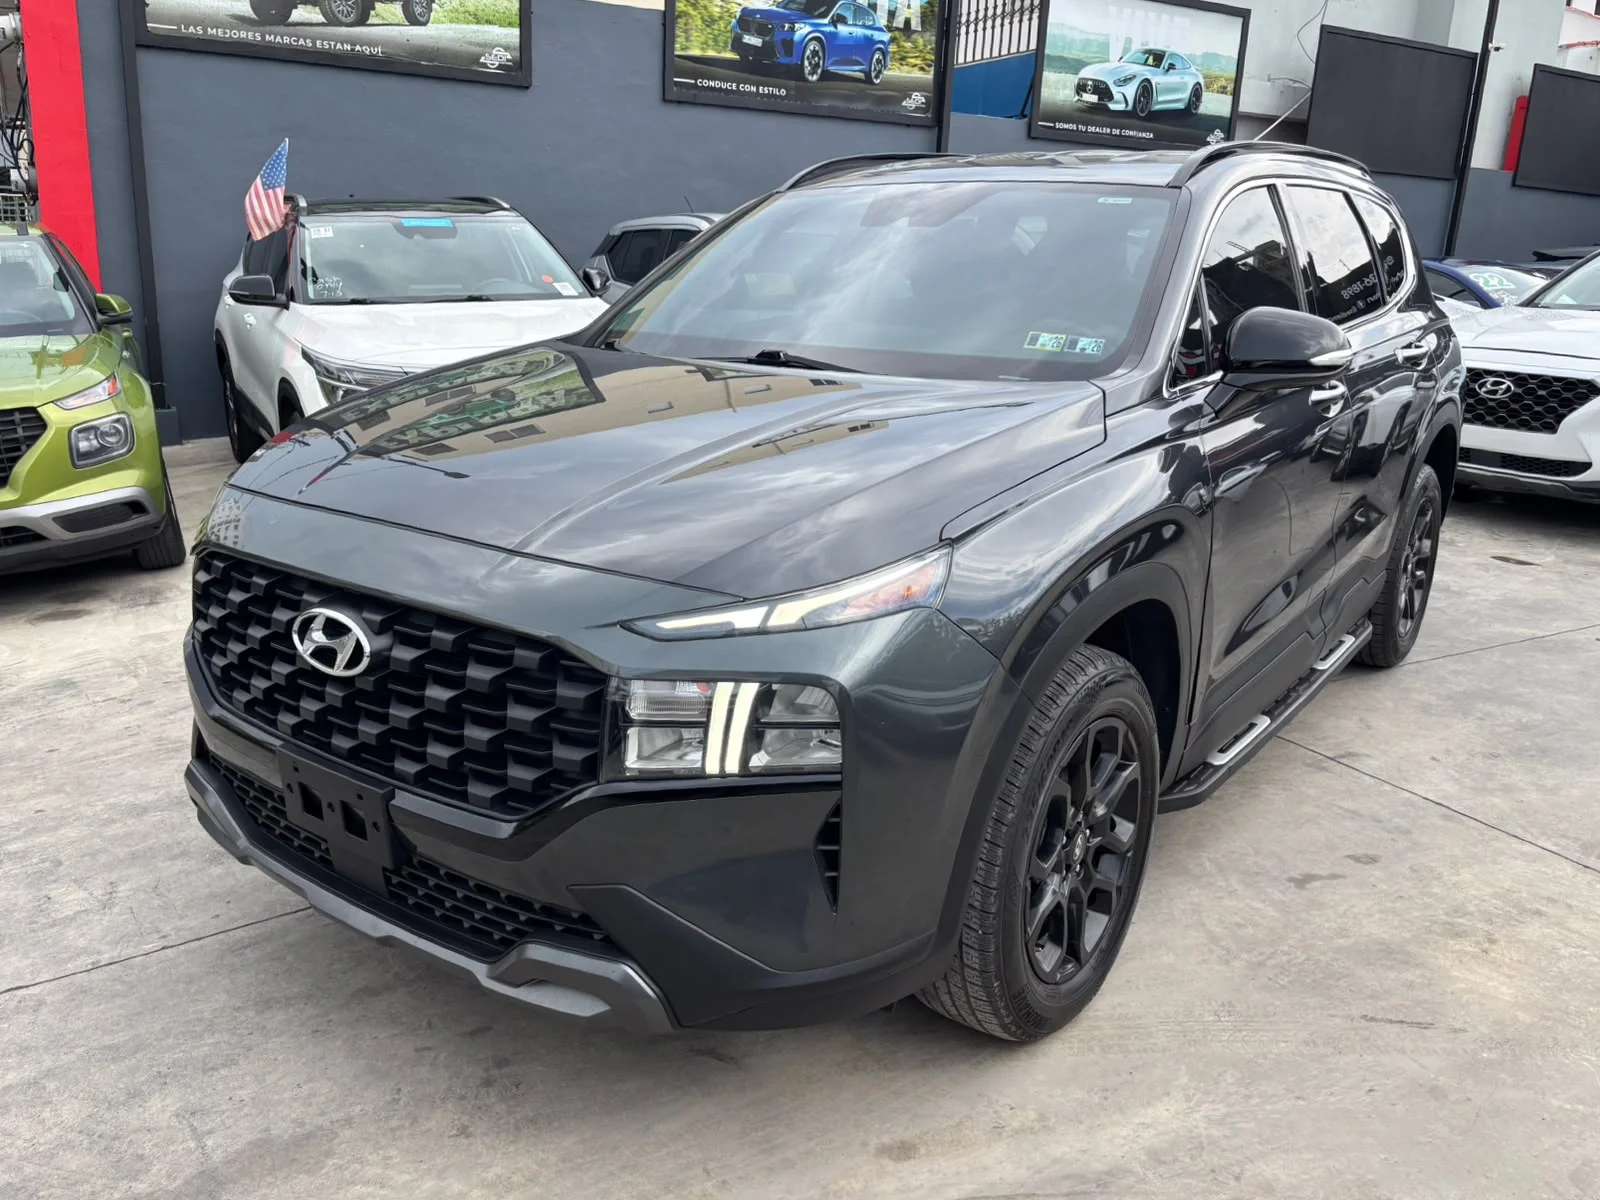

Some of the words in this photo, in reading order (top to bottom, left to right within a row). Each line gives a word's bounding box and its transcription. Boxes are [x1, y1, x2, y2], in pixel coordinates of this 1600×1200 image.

[181, 24, 203, 34] LAS
[207, 27, 262, 41] MEJORES
[265, 34, 312, 47] MARCAS
[316, 40, 351, 51] ESTAN
[697, 79, 737, 90] CONDUCE
[739, 84, 757, 93] CON
[760, 86, 787, 96] ESTILO
[1055, 122, 1077, 130] SOMOS
[1078, 124, 1087, 132] TU
[1087, 126, 1111, 134] DEALER
[1121, 129, 1154, 138] CONFIANZA
